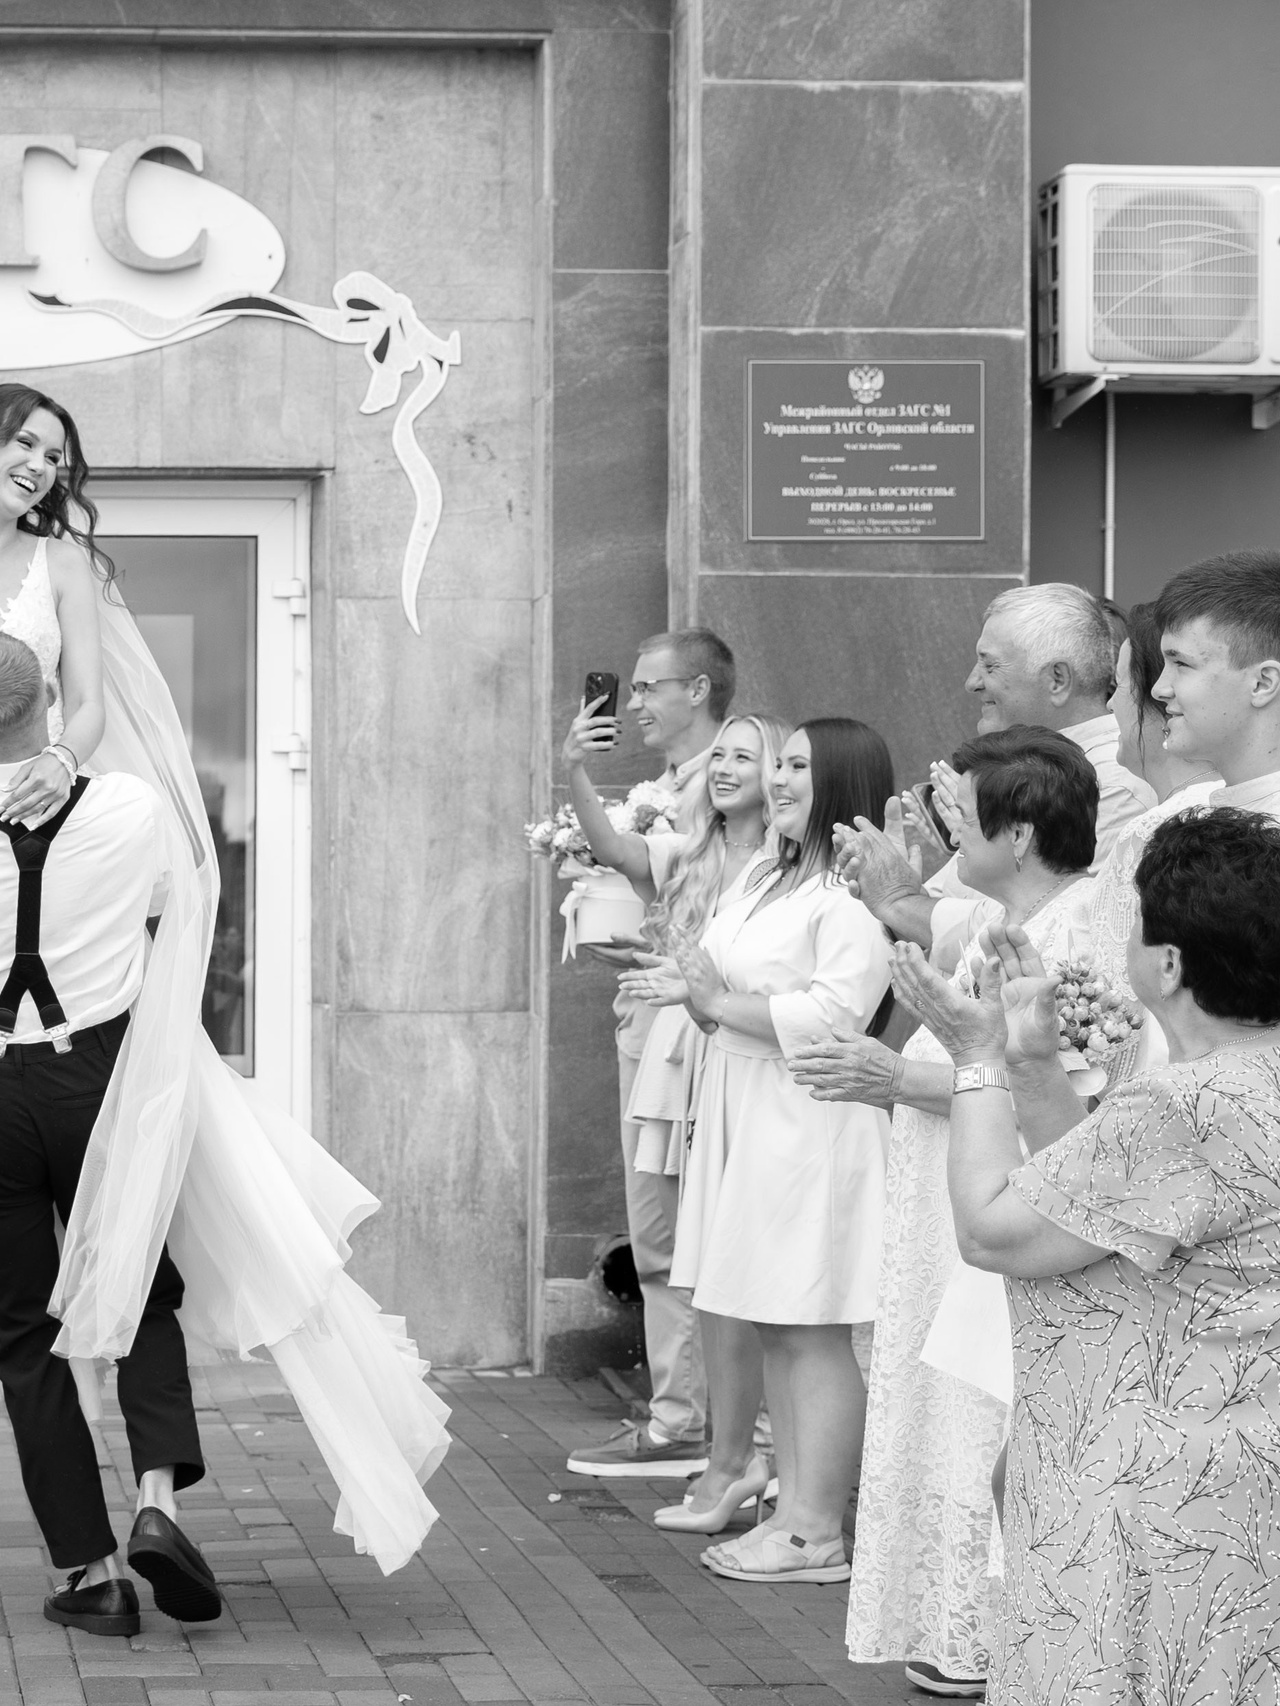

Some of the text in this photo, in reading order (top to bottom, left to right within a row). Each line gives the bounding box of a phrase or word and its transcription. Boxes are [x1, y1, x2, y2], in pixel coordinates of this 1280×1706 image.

[864, 407, 896, 417] отдел
[897, 404, 931, 417] ЗАГС
[931, 404, 951, 417] №1
[763, 421, 975, 437] Управления ЗАГС Орловской области
[781, 485, 957, 498] ВЫХОДНОЙ ДЕНЬ: ВОСКРЕСЕНЬЕ
[811, 502, 862, 512] ПЕРЕРЫВ
